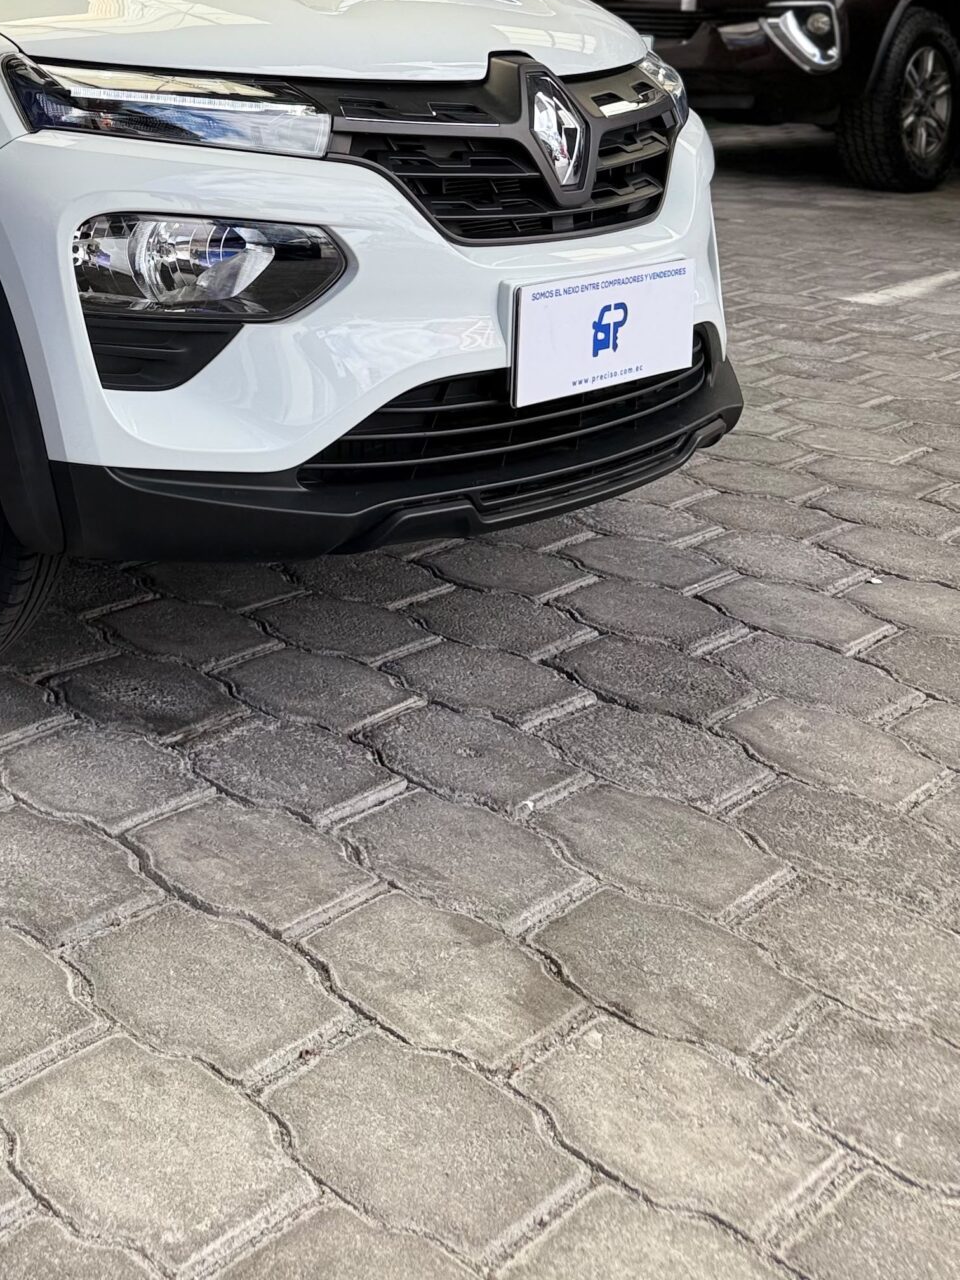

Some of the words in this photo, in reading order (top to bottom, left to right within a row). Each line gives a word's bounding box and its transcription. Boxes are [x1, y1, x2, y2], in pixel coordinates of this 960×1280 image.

[531, 289, 554, 301] SOMOS
[554, 288, 562, 297] EL
[563, 285, 580, 296] NEXO
[581, 282, 600, 293] ENTRE
[600, 274, 644, 289] COMPRADORES
[649, 267, 687, 281] VENDEDORES
